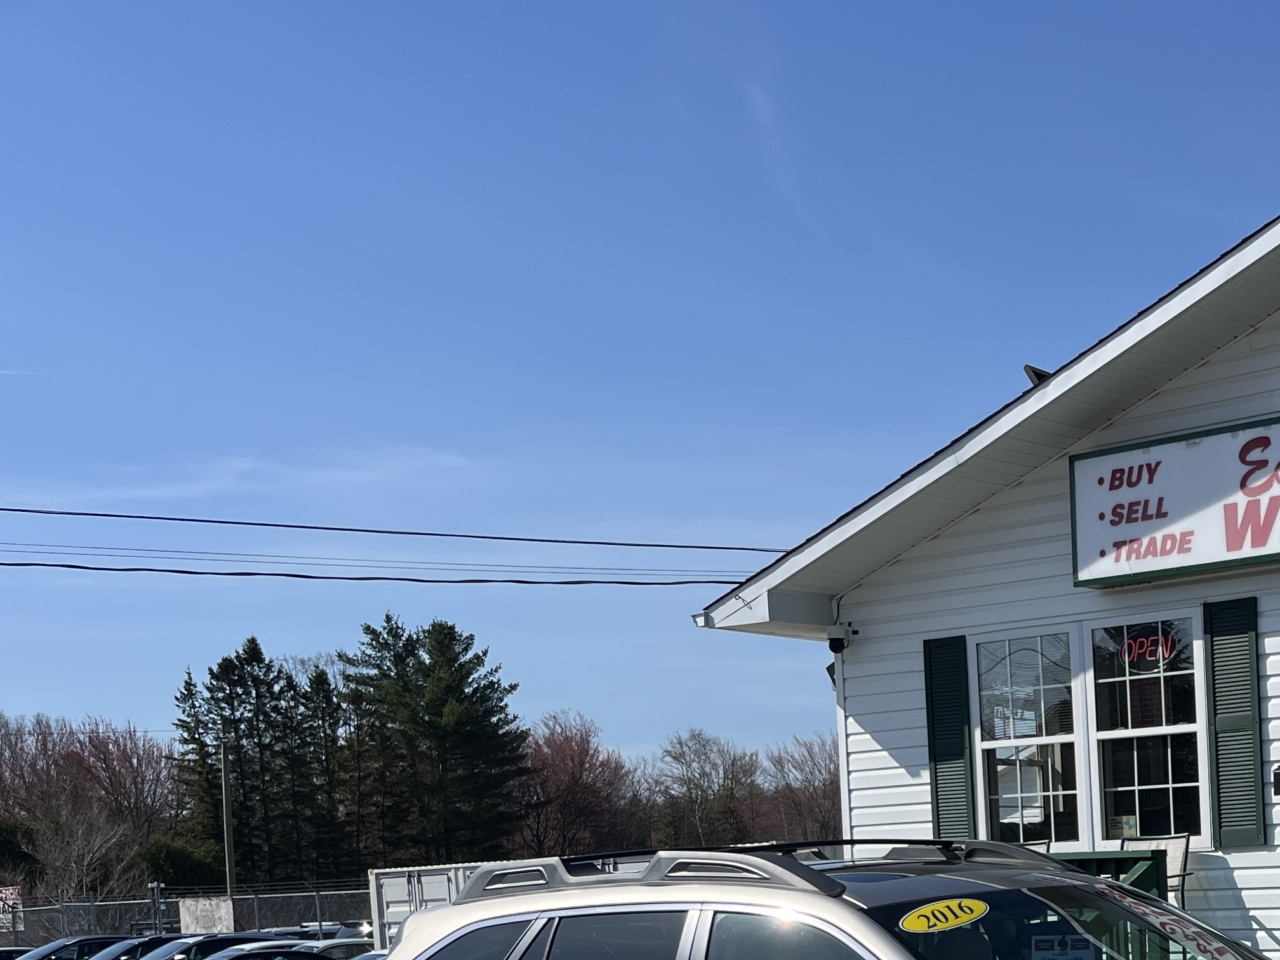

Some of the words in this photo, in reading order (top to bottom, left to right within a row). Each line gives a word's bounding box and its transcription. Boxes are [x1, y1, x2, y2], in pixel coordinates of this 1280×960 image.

[1109, 461, 1162, 491] BUY
[1110, 497, 1169, 527] SELL
[1112, 530, 1195, 563] TRADE
[1121, 633, 1173, 662] OPEN
[917, 900, 975, 930] 2016
